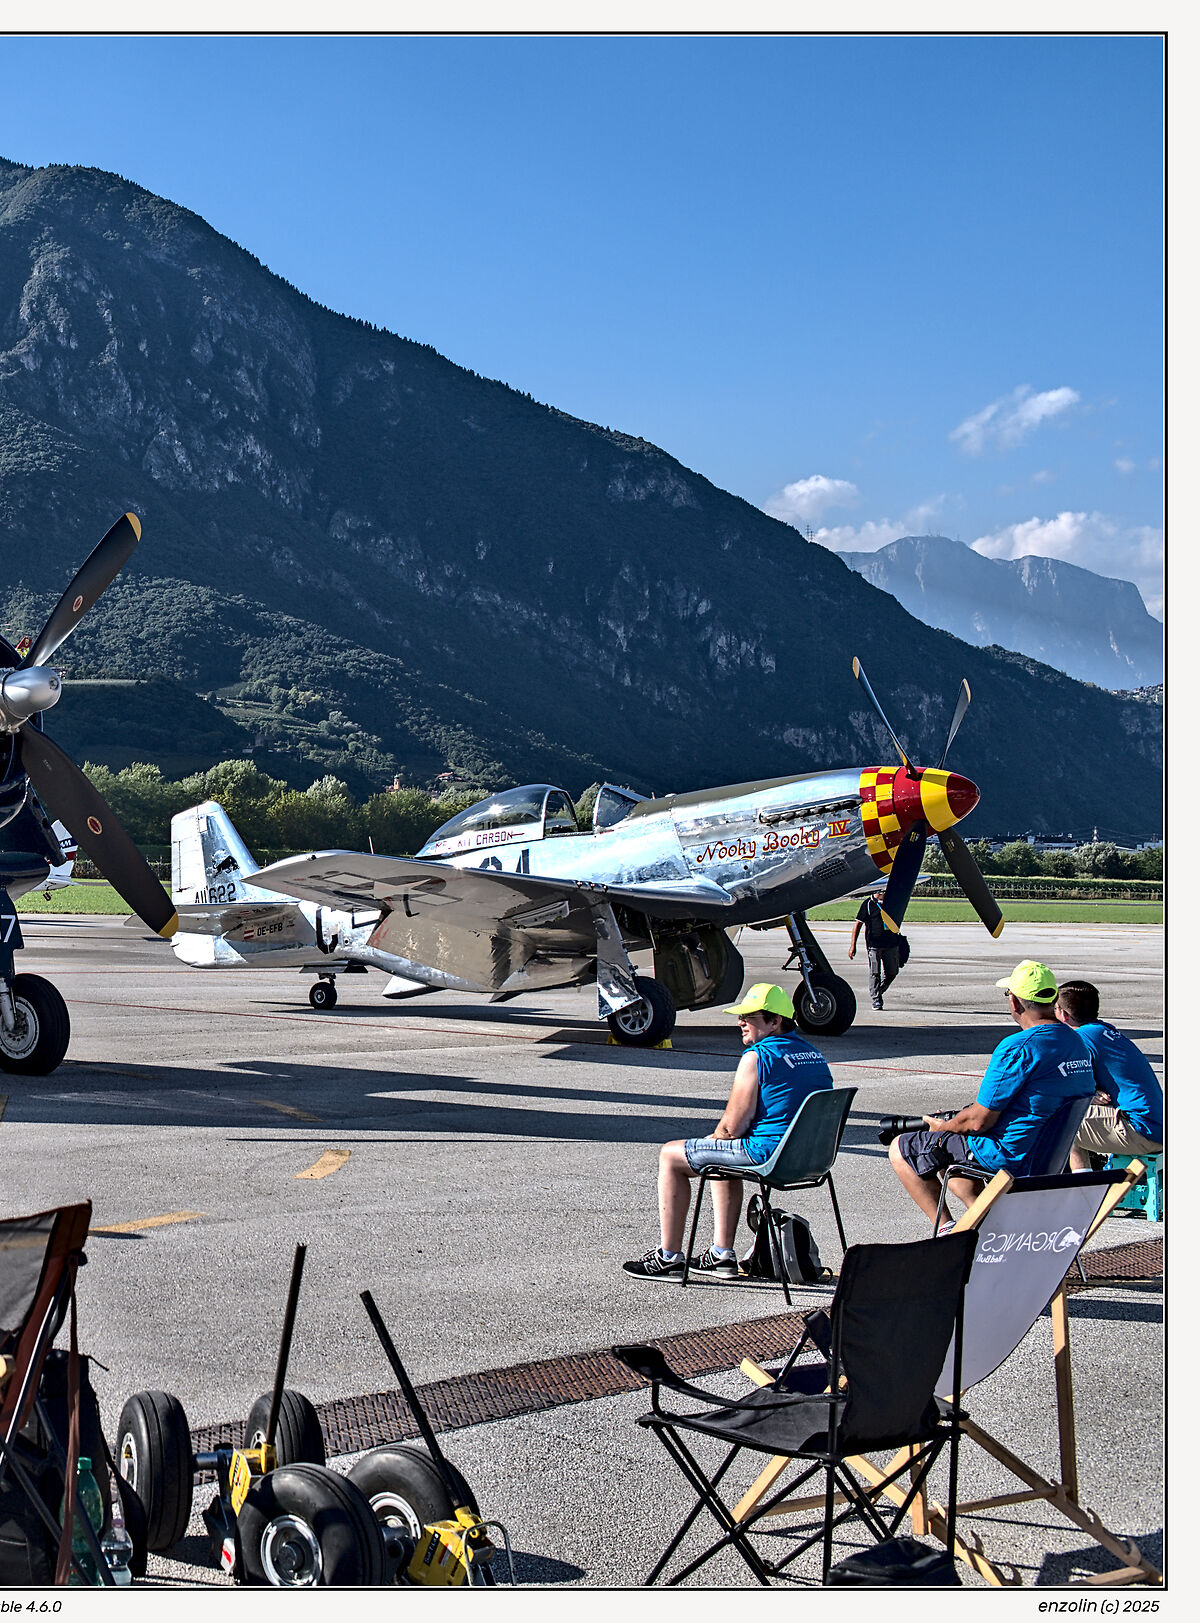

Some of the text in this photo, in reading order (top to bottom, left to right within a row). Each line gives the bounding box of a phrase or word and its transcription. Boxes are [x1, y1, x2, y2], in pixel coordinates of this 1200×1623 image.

[696, 819, 851, 863] Nooky Booky IV
